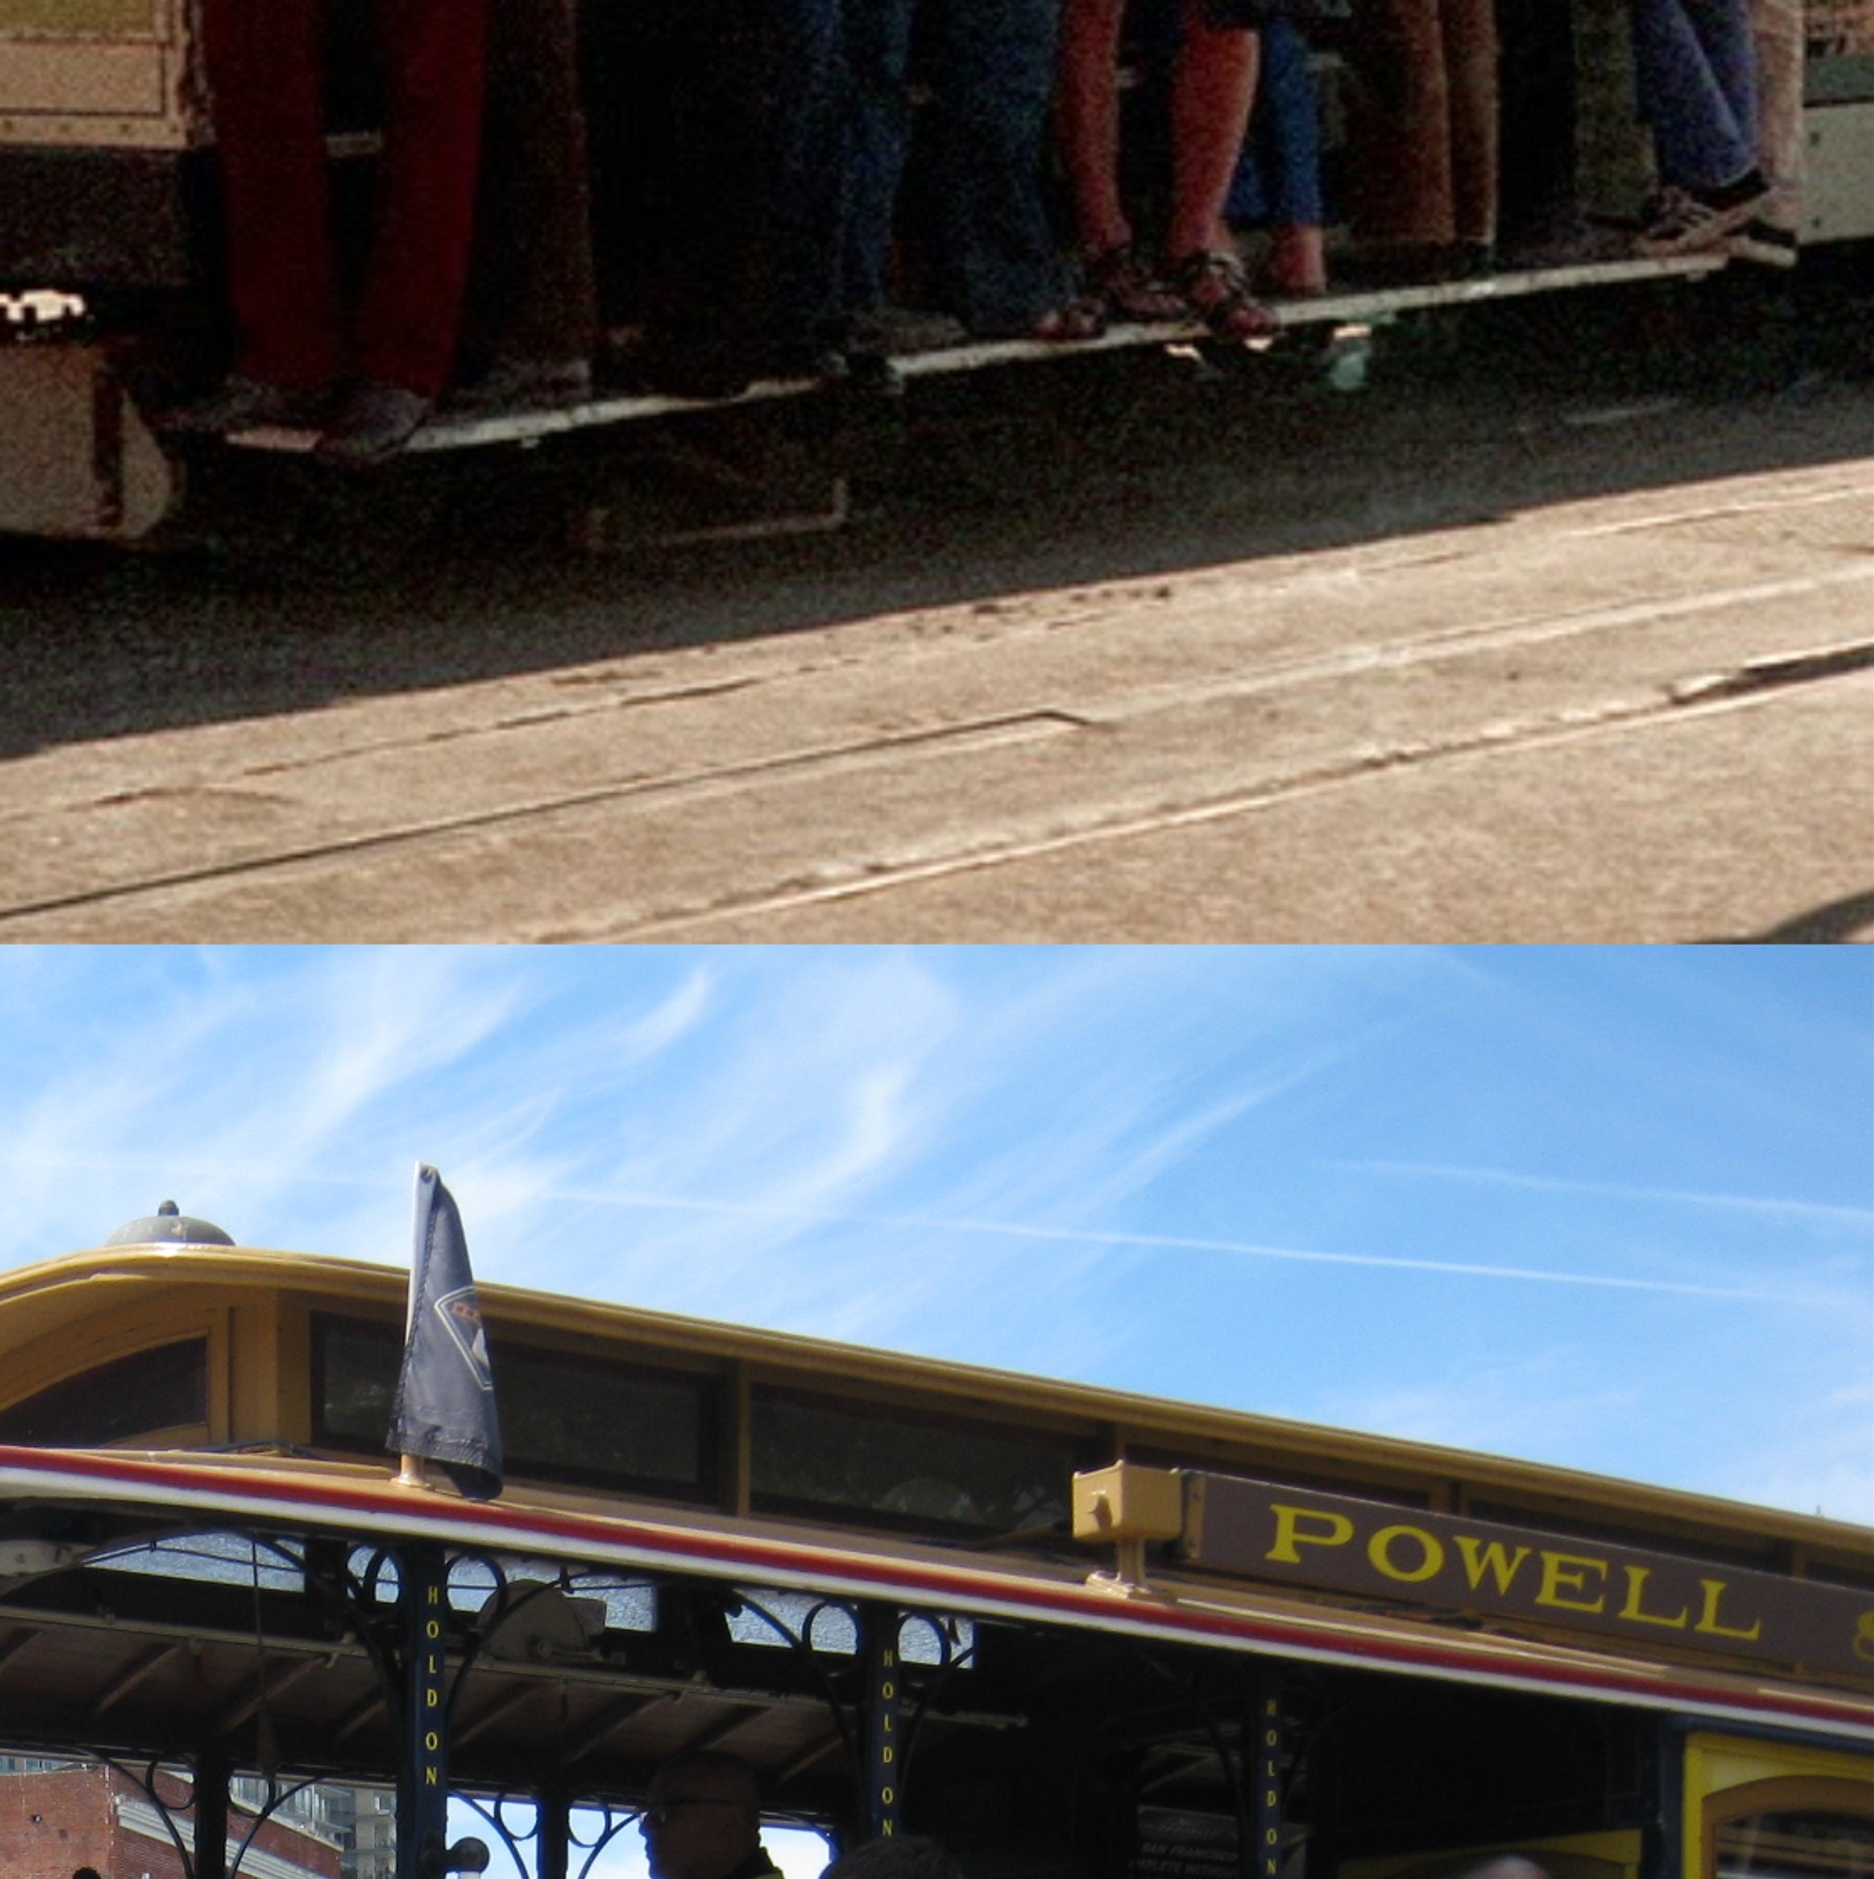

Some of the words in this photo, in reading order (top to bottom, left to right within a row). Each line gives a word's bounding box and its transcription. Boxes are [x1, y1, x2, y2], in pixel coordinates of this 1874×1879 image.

[1265, 1503, 1763, 1642] POWELL
[426, 1586, 439, 1708] HOLD
[426, 1732, 439, 1785] ON
